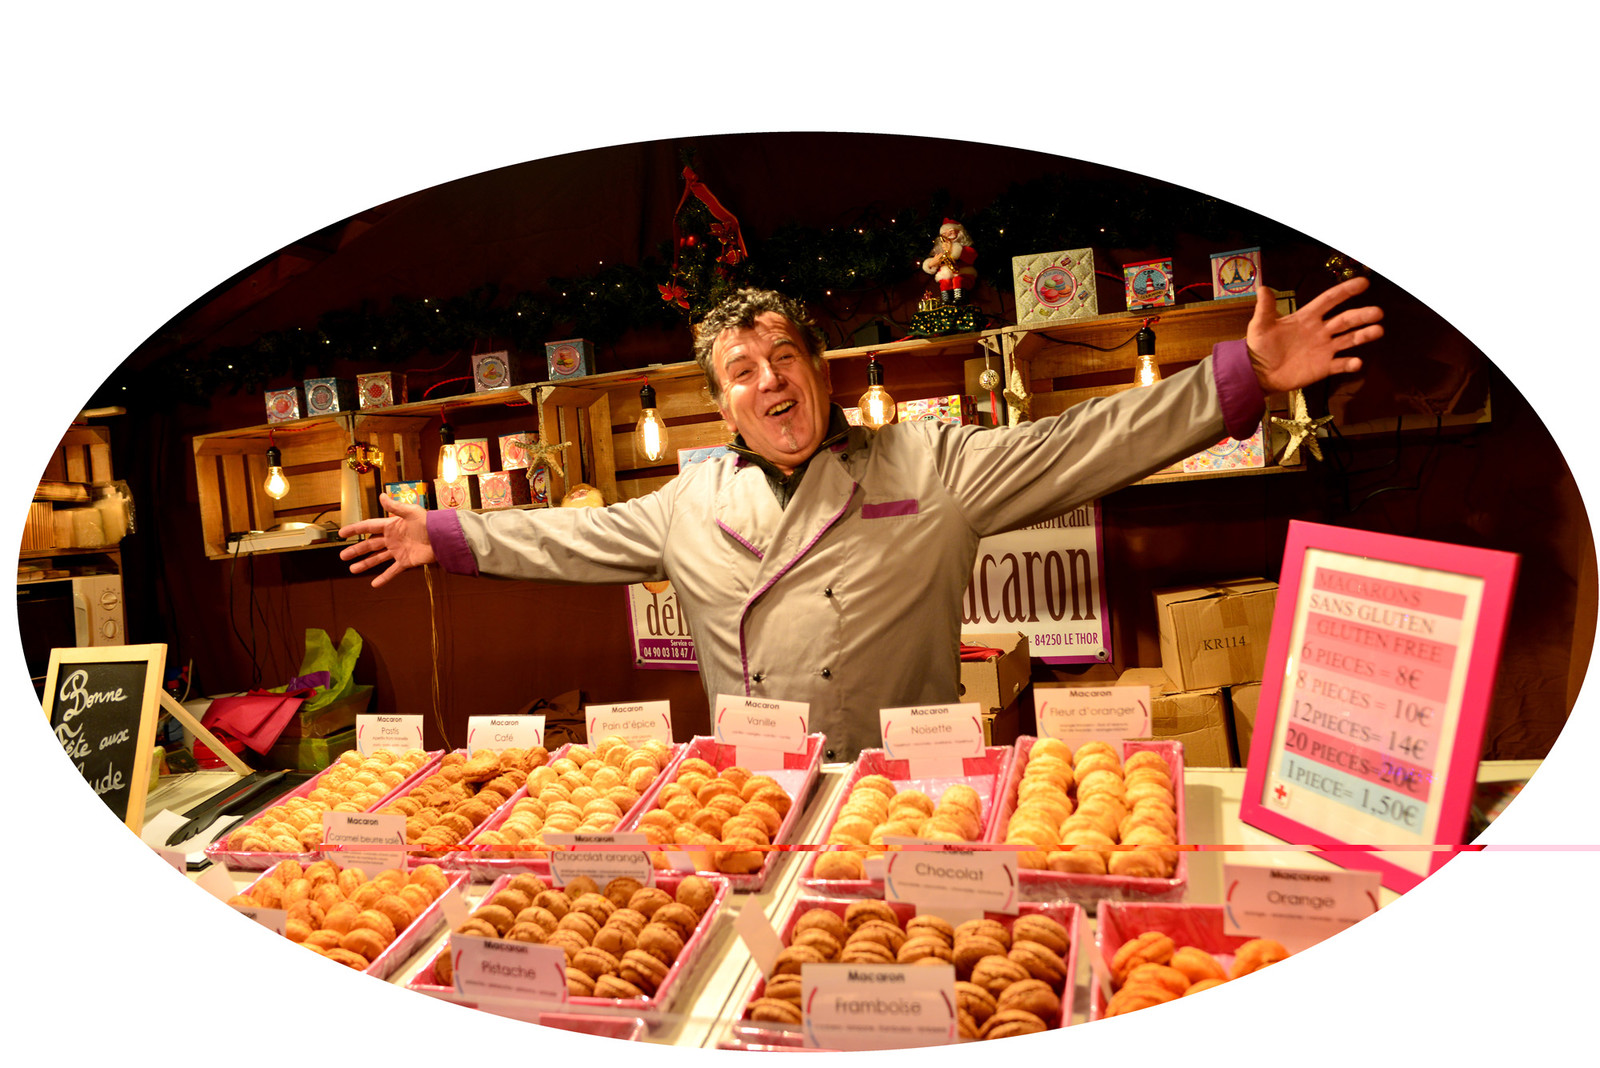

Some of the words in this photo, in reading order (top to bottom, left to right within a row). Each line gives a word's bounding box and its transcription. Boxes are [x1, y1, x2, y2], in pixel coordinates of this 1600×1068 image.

[1030, 504, 1090, 530] ricant
[962, 548, 1096, 624] acaron
[1319, 572, 1422, 607] MACARONS
[1309, 594, 1355, 617] SANS
[1357, 604, 1434, 634] GLUTEN
[1035, 634, 1061, 646] 84250
[1064, 633, 1073, 645] LE
[1075, 632, 1099, 644] THOR
[1203, 635, 1246, 650] KR114
[1317, 618, 1389, 649] GLUTEN
[1392, 637, 1443, 664] FREE
[644, 647, 652, 658] 04
[653, 647, 661, 658] 90
[662, 647, 670, 658] 03
[671, 648, 680, 658] 18
[680, 648, 688, 658] 47
[1302, 641, 1312, 660] 6
[1315, 648, 1376, 676] PIECES
[1395, 665, 1424, 690] 8€
[60, 669, 128, 722] Bonne
[1069, 690, 1112, 698] Macaron
[1296, 670, 1308, 690] 8
[1311, 678, 1372, 710] PIECES
[1394, 699, 1434, 728] 10€
[612, 705, 644, 714] Macaron
[745, 700, 780, 710] Macaron
[910, 707, 948, 716] Macaron
[1050, 706, 1076, 717] Fleur
[1080, 706, 1136, 718] d'oranger
[602, 722, 620, 730] Pain
[622, 720, 656, 732] d'épice
[747, 716, 776, 728] Vanille
[910, 723, 952, 735] Noisette
[381, 726, 400, 735] Pastis
[99, 728, 129, 750] aux
[494, 733, 514, 743] Café
[1286, 728, 1308, 750] 20
[1389, 731, 1429, 760] 14€
[1362, 788, 1420, 827] 1,50€
[347, 817, 378, 826] Macaron
[329, 833, 360, 843] Caramel
[361, 834, 383, 844] beurre
[384, 834, 399, 844] salé
[554, 852, 602, 862] Chocolat
[606, 853, 645, 864] orange
[915, 862, 984, 882] Chocolat
[1270, 870, 1331, 882] Macaron
[1266, 890, 1336, 909] Orange
[484, 940, 528, 954] Macaron
[481, 960, 536, 980] Pistache
[847, 970, 905, 982] Macaron
[835, 998, 922, 1016] Framboise
